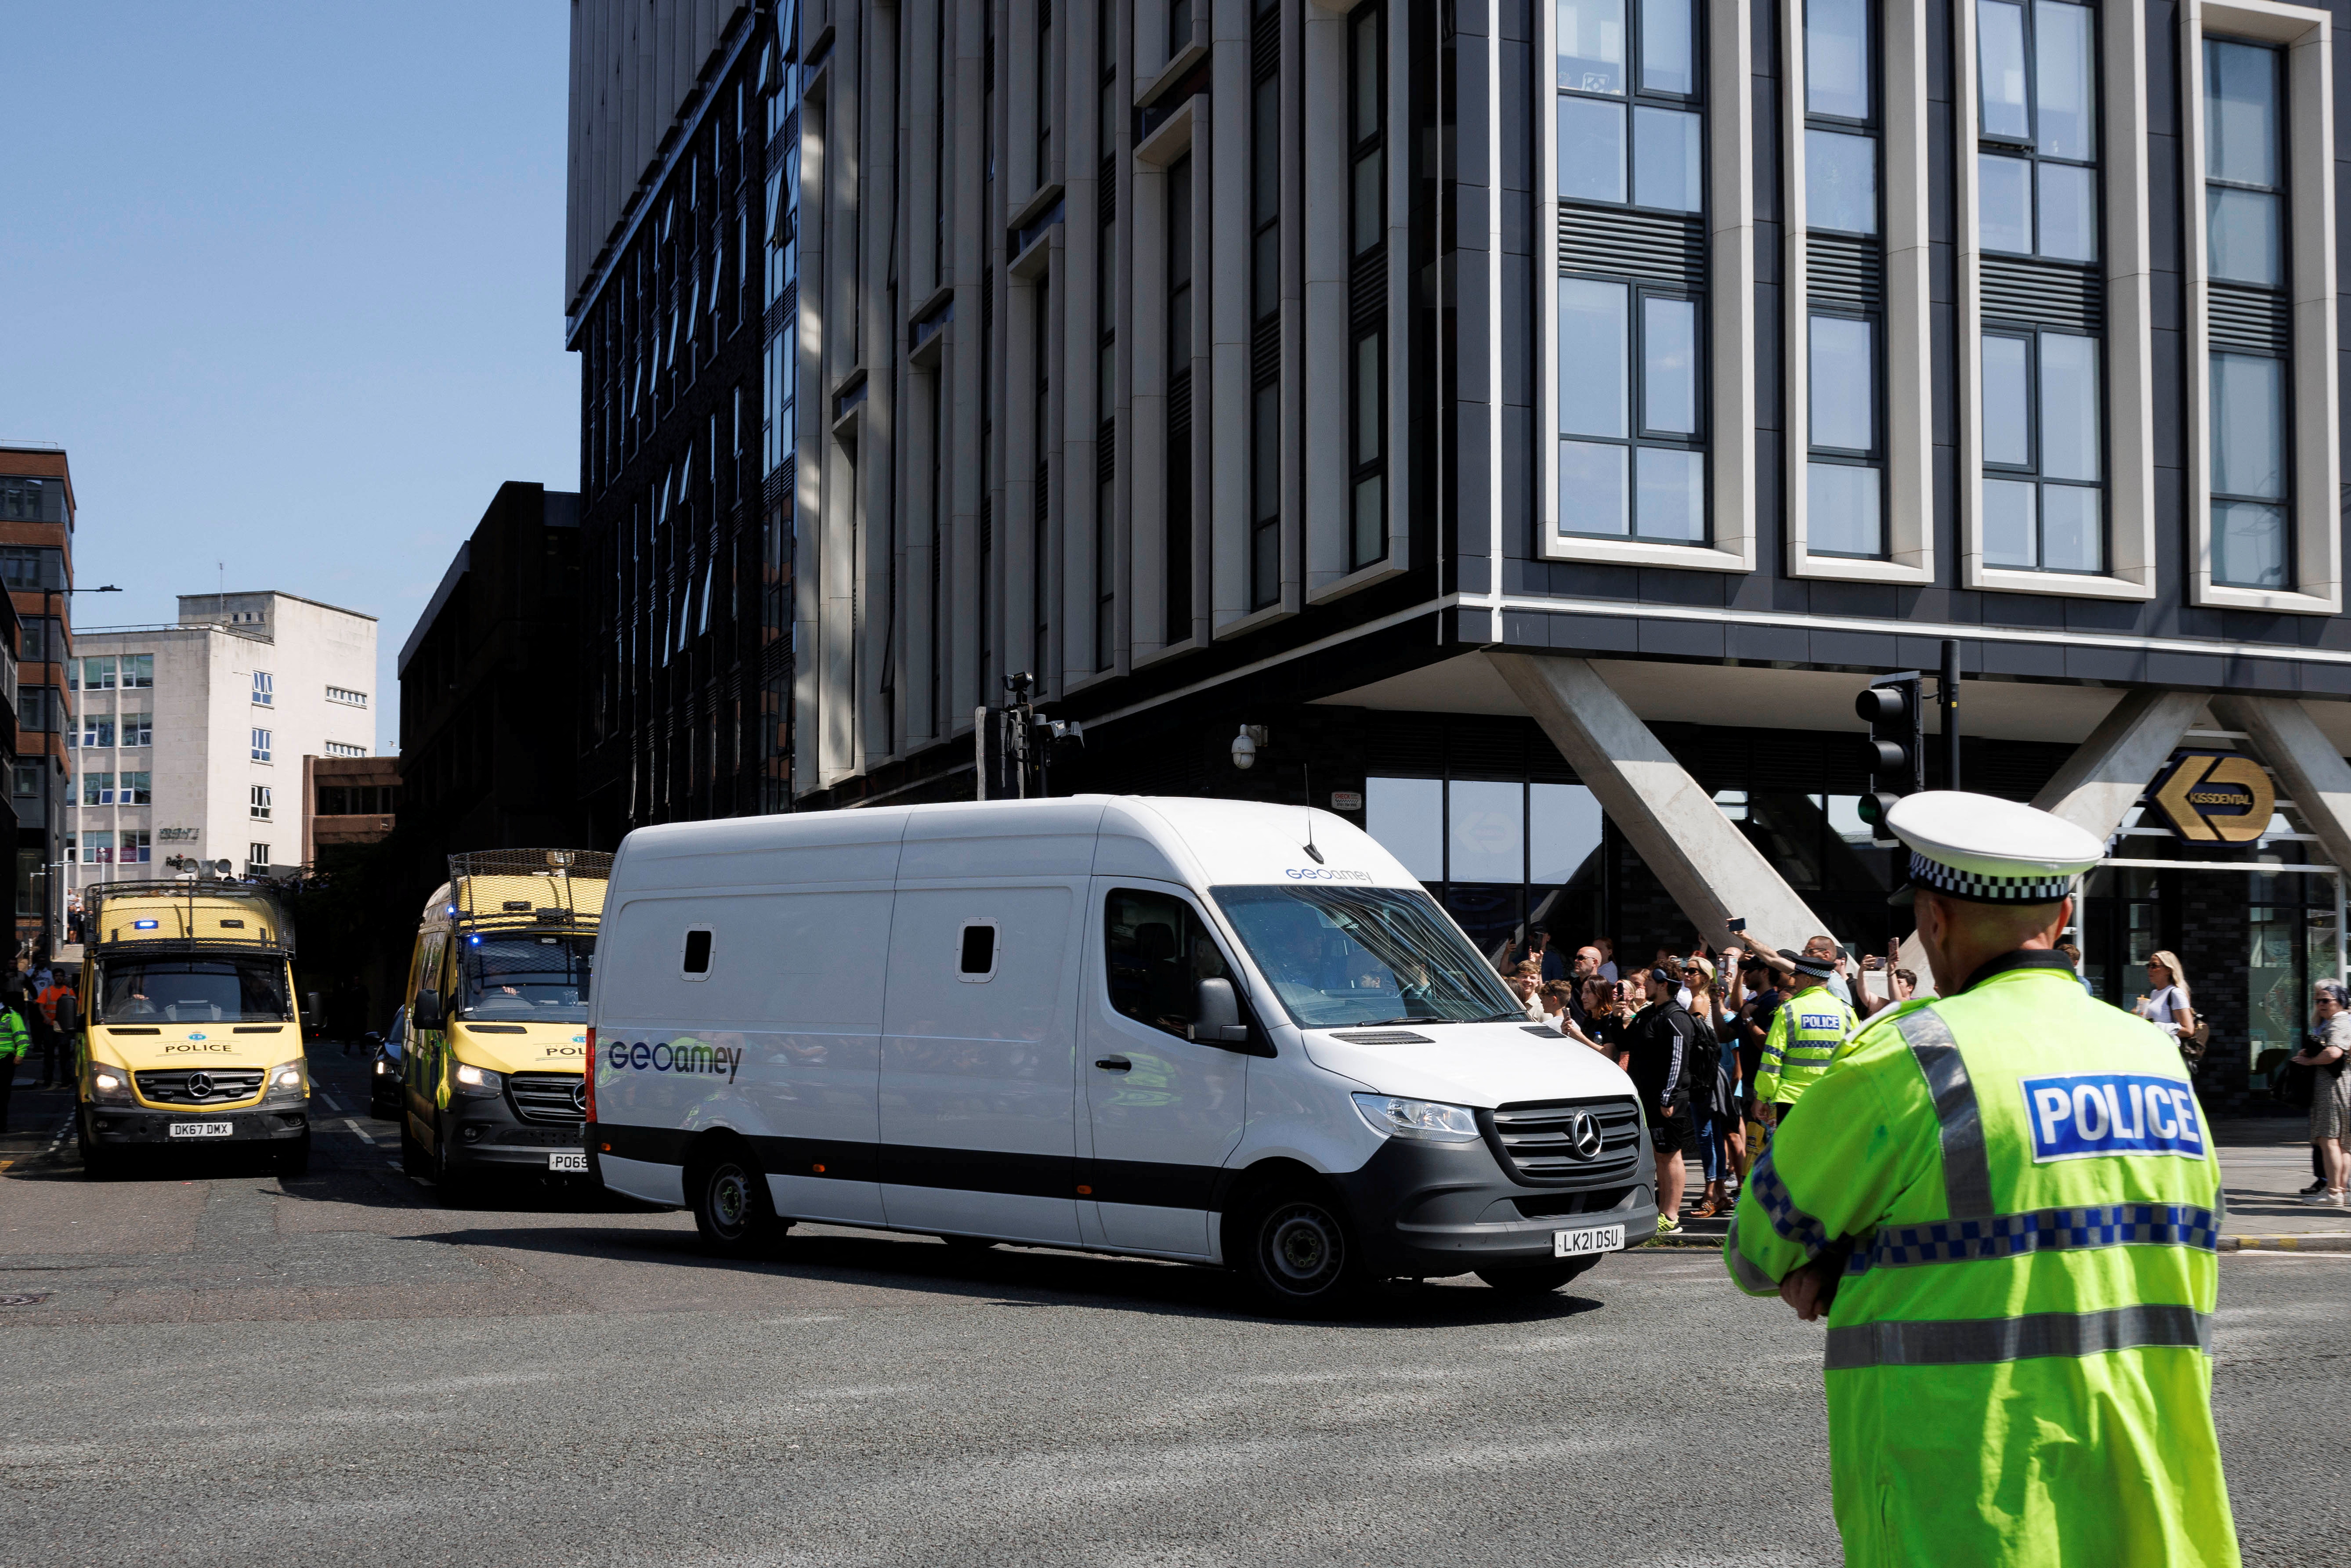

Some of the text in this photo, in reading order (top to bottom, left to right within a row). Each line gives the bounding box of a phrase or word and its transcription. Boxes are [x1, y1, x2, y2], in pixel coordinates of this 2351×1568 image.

[2189, 792, 2253, 805] KISSDENTAL
[1802, 1015, 1839, 1028] POLICE
[166, 1044, 232, 1053] POLICE
[2033, 1084, 2200, 1144] POLICE
[175, 1124, 227, 1135] DK67 DMX
[1564, 1229, 1618, 1252] LK21 DSU
